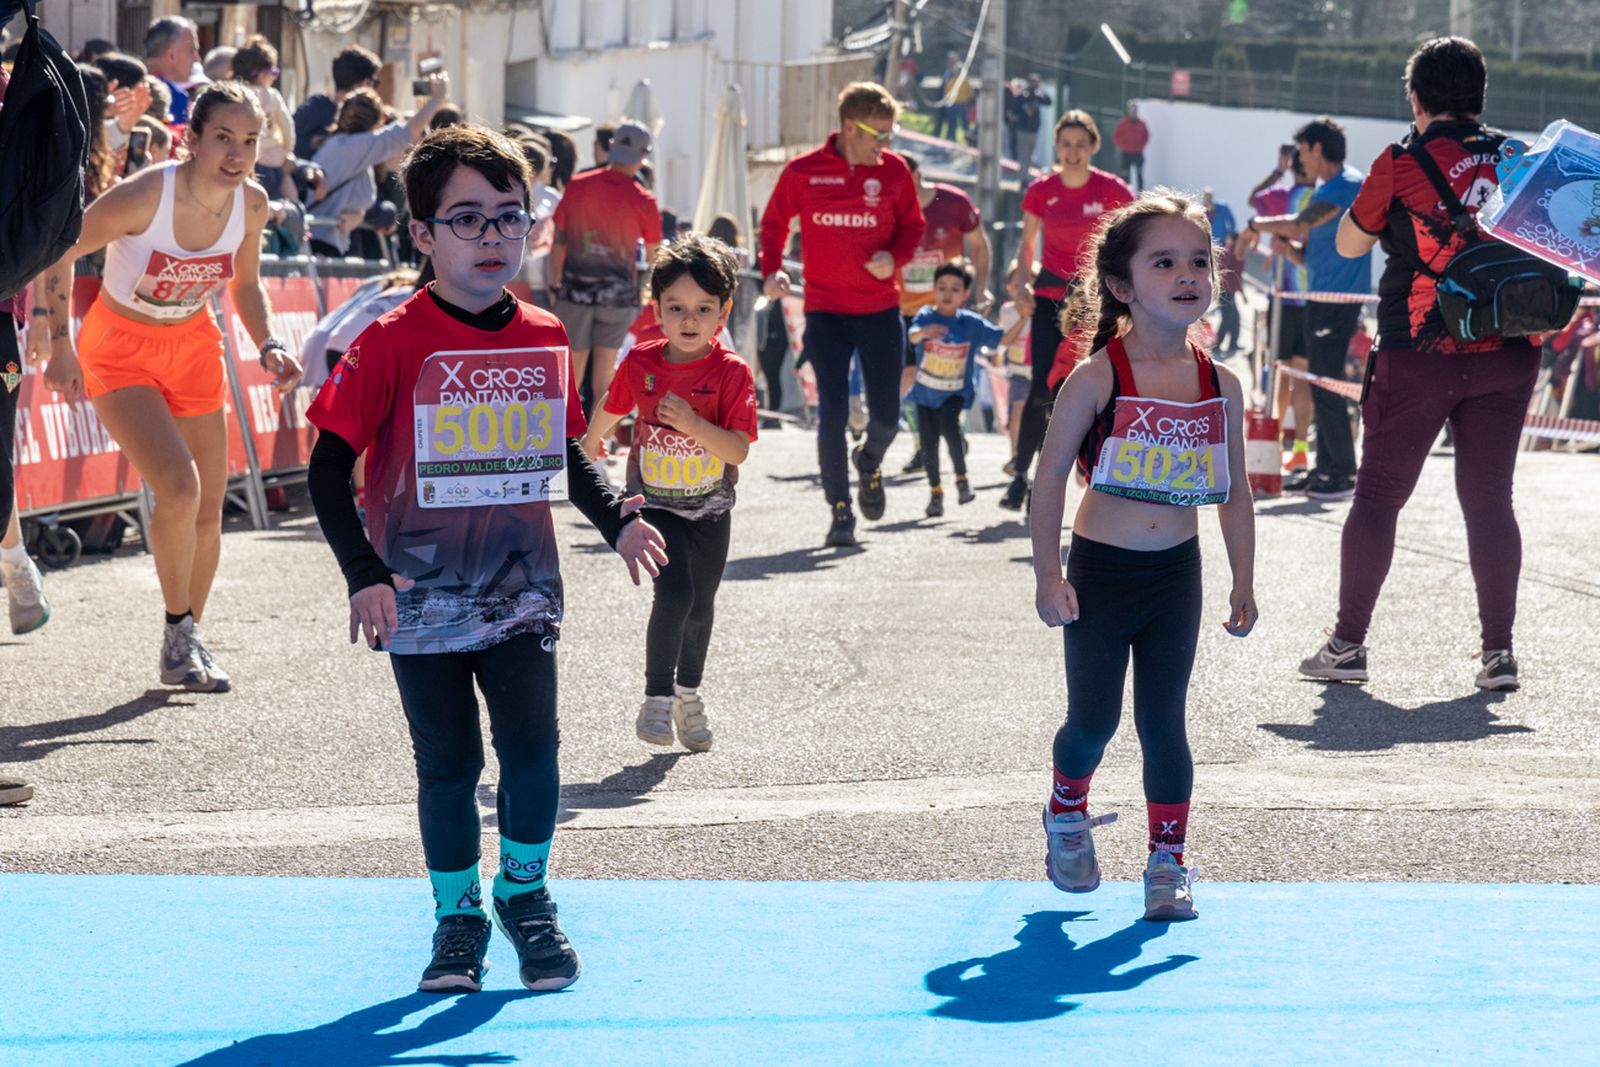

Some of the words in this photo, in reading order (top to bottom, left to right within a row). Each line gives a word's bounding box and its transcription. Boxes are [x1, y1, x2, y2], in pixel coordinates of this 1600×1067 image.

[1514, 226, 1573, 257] CROSS
[161, 257, 180, 274] X
[178, 262, 223, 275] CROSS
[152, 280, 217, 300] 877
[439, 361, 465, 389] X
[470, 366, 546, 389] CROSS
[440, 388, 531, 408] PANTANO
[433, 403, 552, 455] 5003
[1130, 406, 1155, 430] X
[1156, 416, 1210, 436] CROSS
[647, 425, 662, 444] X
[664, 434, 702, 448] CRO
[1125, 429, 1199, 451] PANTANO
[647, 443, 705, 458] PANTANO
[419, 463, 460, 474] PEDRO
[643, 451, 720, 486] 5004
[1111, 442, 1215, 489] 5021
